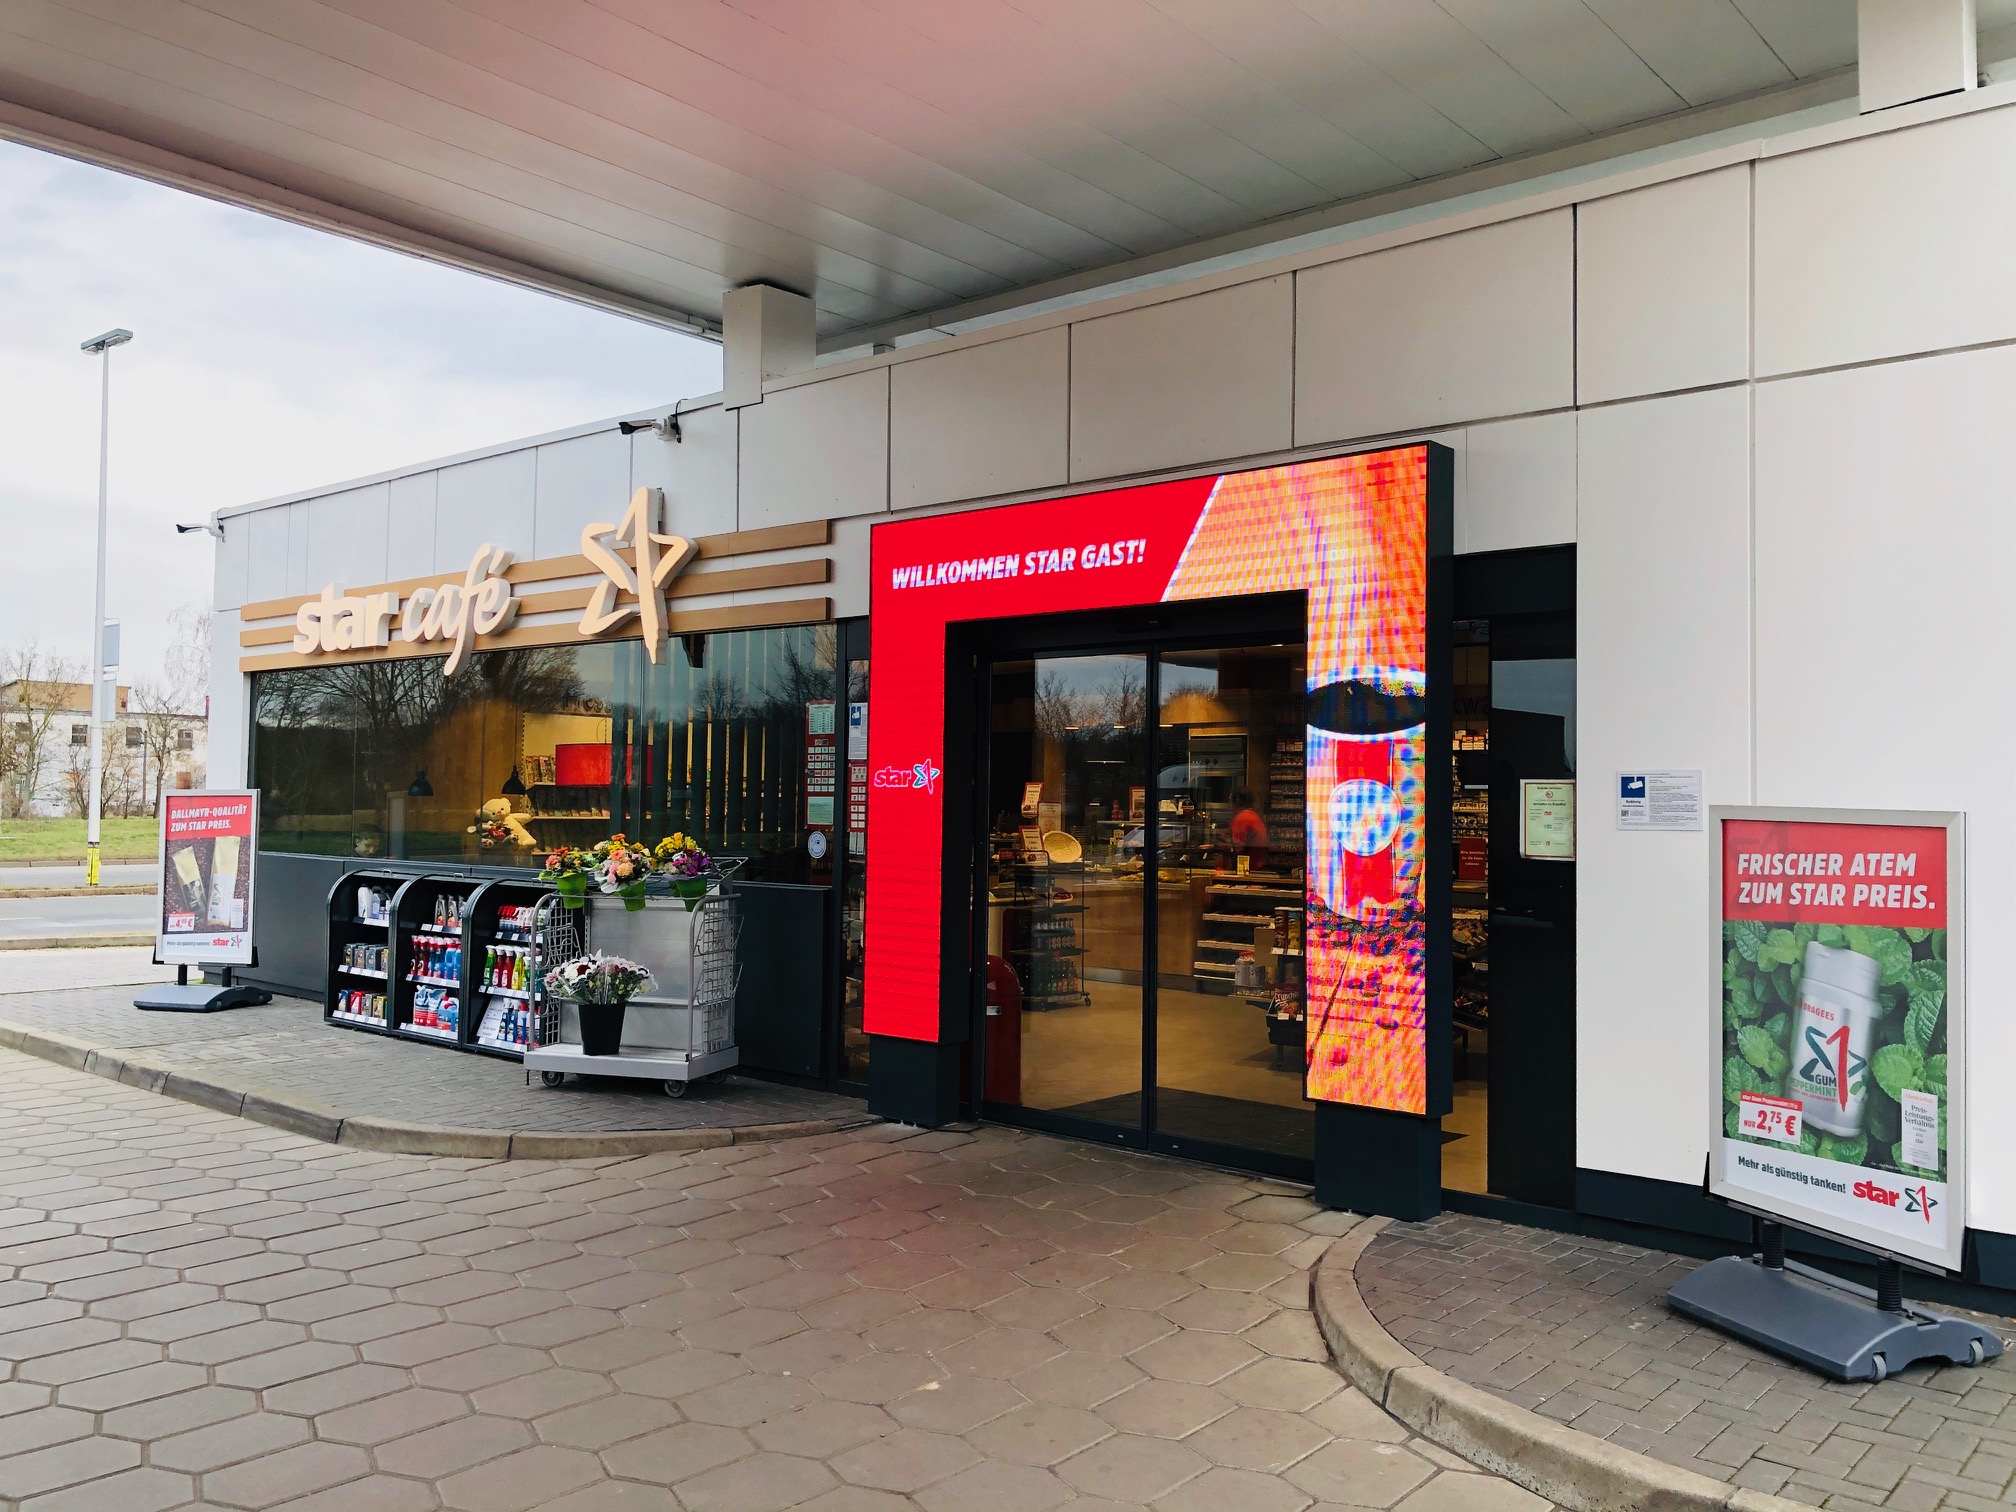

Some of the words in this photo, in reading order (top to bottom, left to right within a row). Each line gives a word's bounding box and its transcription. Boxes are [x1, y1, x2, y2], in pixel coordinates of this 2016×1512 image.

[892, 554, 1020, 589] WILLKOMMEN
[1024, 547, 1076, 576] STAR
[1081, 538, 1147, 569] GAST!
[293, 583, 399, 655] star
[402, 543, 521, 676] café
[874, 766, 912, 788] star
[171, 804, 247, 819] DALLMAYR-QUALITÄT
[171, 822, 187, 832] ZUM
[188, 821, 206, 830] STAR
[208, 819, 231, 829] PREIS.
[1738, 853, 1843, 876] FRISCHER
[1850, 853, 1917, 877] ATEM
[1738, 882, 1783, 905] ZUM
[1788, 883, 1846, 907] STAR
[1853, 885, 1936, 910] PREIS.
[212, 938, 229, 947] star
[1815, 1074, 1837, 1087] GUM
[1904, 1110, 1936, 1123] Leistungs-
[1911, 1104, 1928, 1114] Preis-
[1743, 1119, 1756, 1128] NUR
[1904, 1116, 1936, 1129] Verhältnis
[1738, 1156, 1760, 1170] Mehr
[1761, 1163, 1774, 1174] als
[1775, 1165, 1808, 1185] günstig
[1811, 1175, 1846, 1194] tanken!
[1853, 1180, 1899, 1207] star
